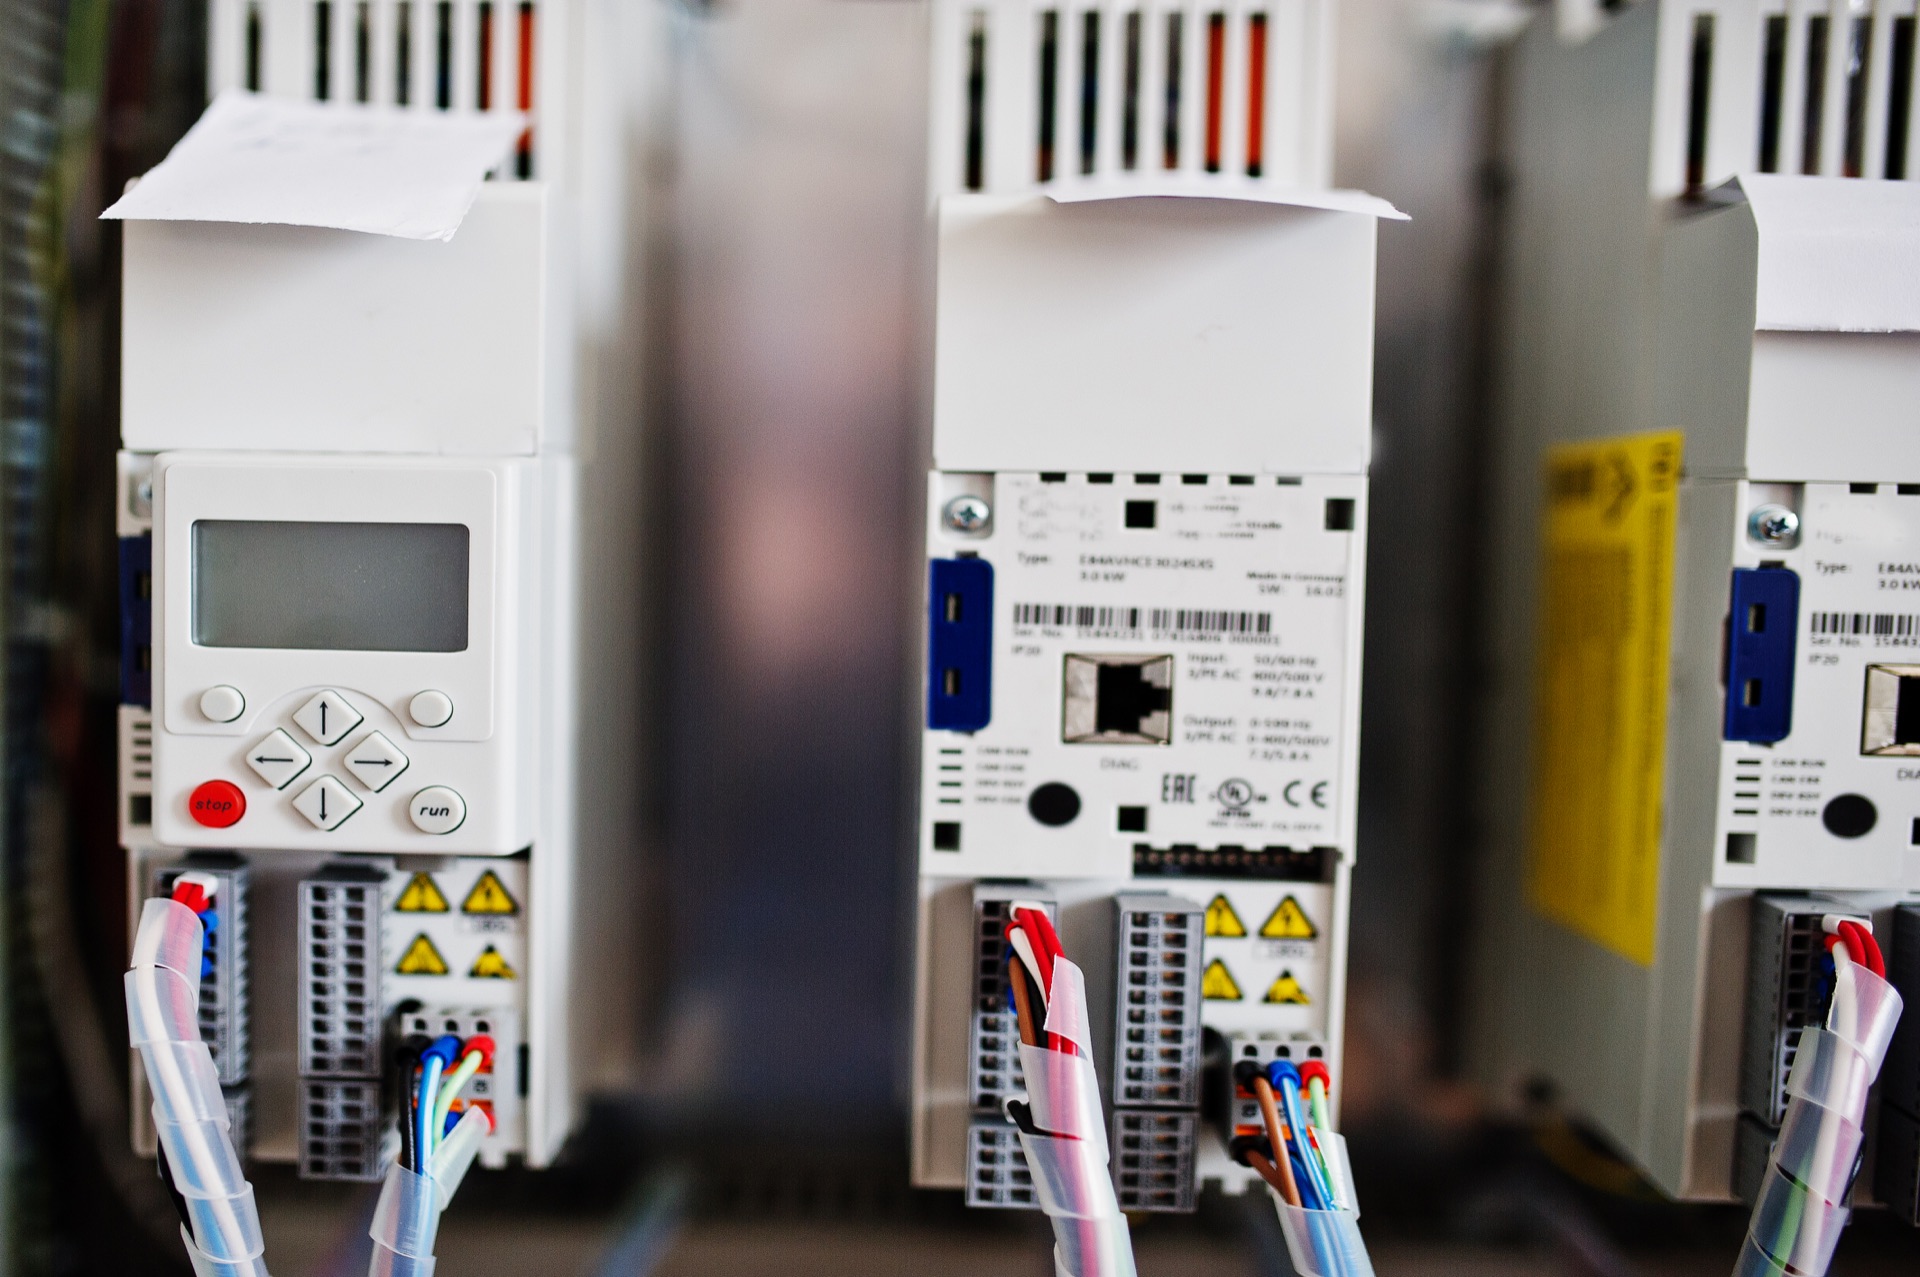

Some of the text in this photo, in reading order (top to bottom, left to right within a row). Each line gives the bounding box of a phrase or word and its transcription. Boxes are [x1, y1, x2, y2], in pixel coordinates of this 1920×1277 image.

[1103, 571, 1126, 582] kW
[1879, 578, 1899, 590] 3.0
[1874, 635, 1920, 647] 15843
[1808, 653, 1840, 666] IP20
[1283, 779, 1329, 809] CE
[195, 799, 232, 813] stop
[419, 804, 451, 817] run
